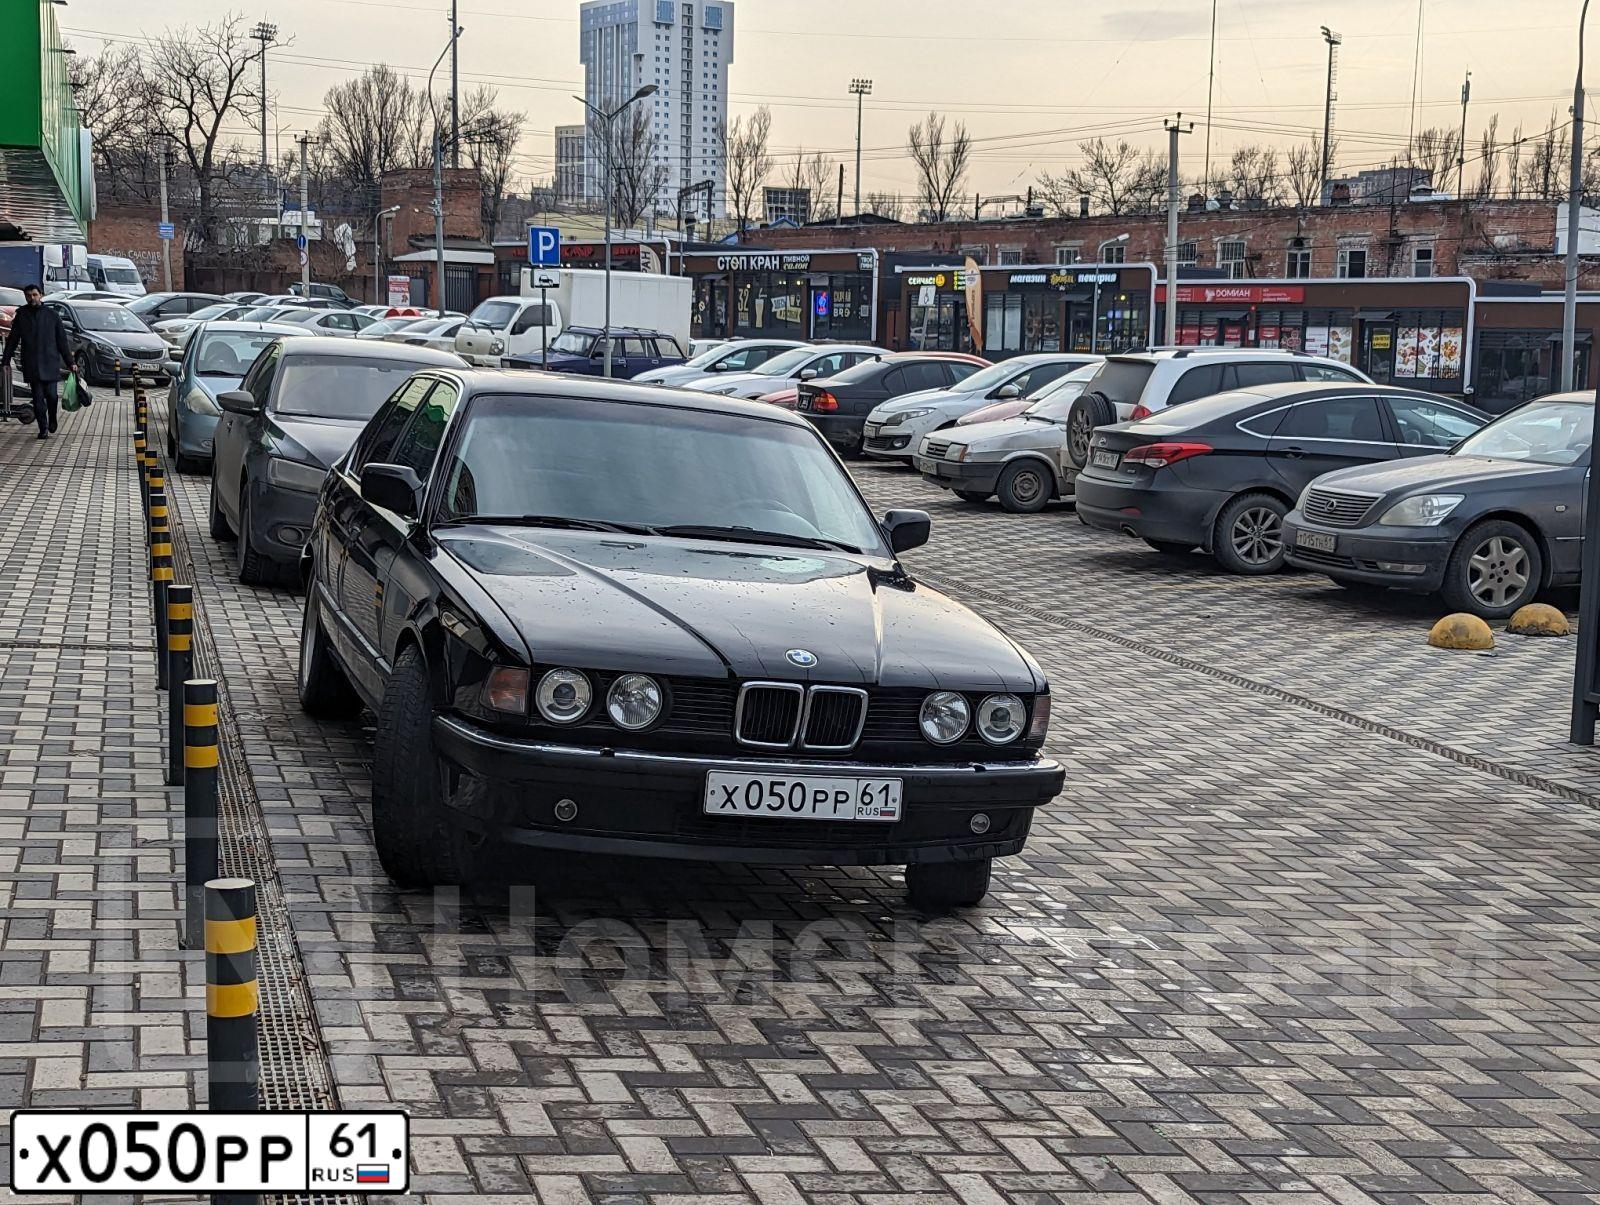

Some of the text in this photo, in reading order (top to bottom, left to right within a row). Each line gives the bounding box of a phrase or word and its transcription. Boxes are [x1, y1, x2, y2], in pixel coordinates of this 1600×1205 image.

[538, 231, 555, 261] P
[717, 256, 780, 270] СТОП КРАН
[783, 262, 808, 270] салон
[719, 779, 890, 814] Х050РР 61
[857, 806, 879, 816] RUS
